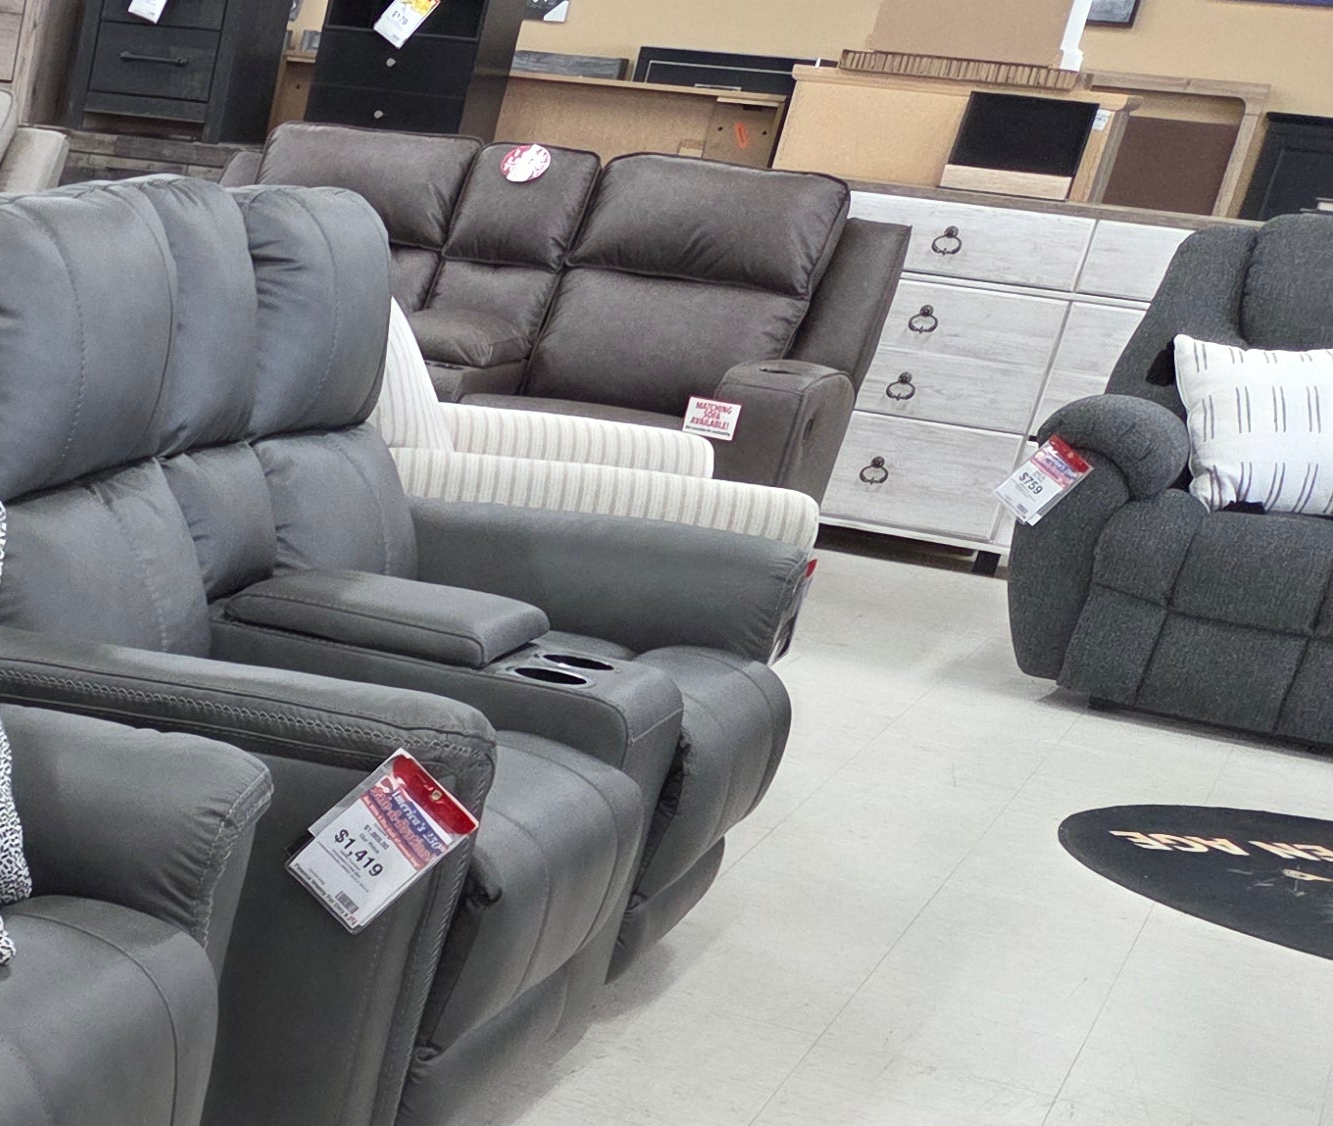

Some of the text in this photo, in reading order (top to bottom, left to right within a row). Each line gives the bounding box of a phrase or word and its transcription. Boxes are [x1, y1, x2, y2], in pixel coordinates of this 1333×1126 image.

[696, 401, 732, 415] MATCHING
[704, 408, 721, 420] SOFA
[1018, 472, 1044, 495] $759
[334, 828, 383, 877] $1,419
[1109, 830, 1250, 856] AGE
